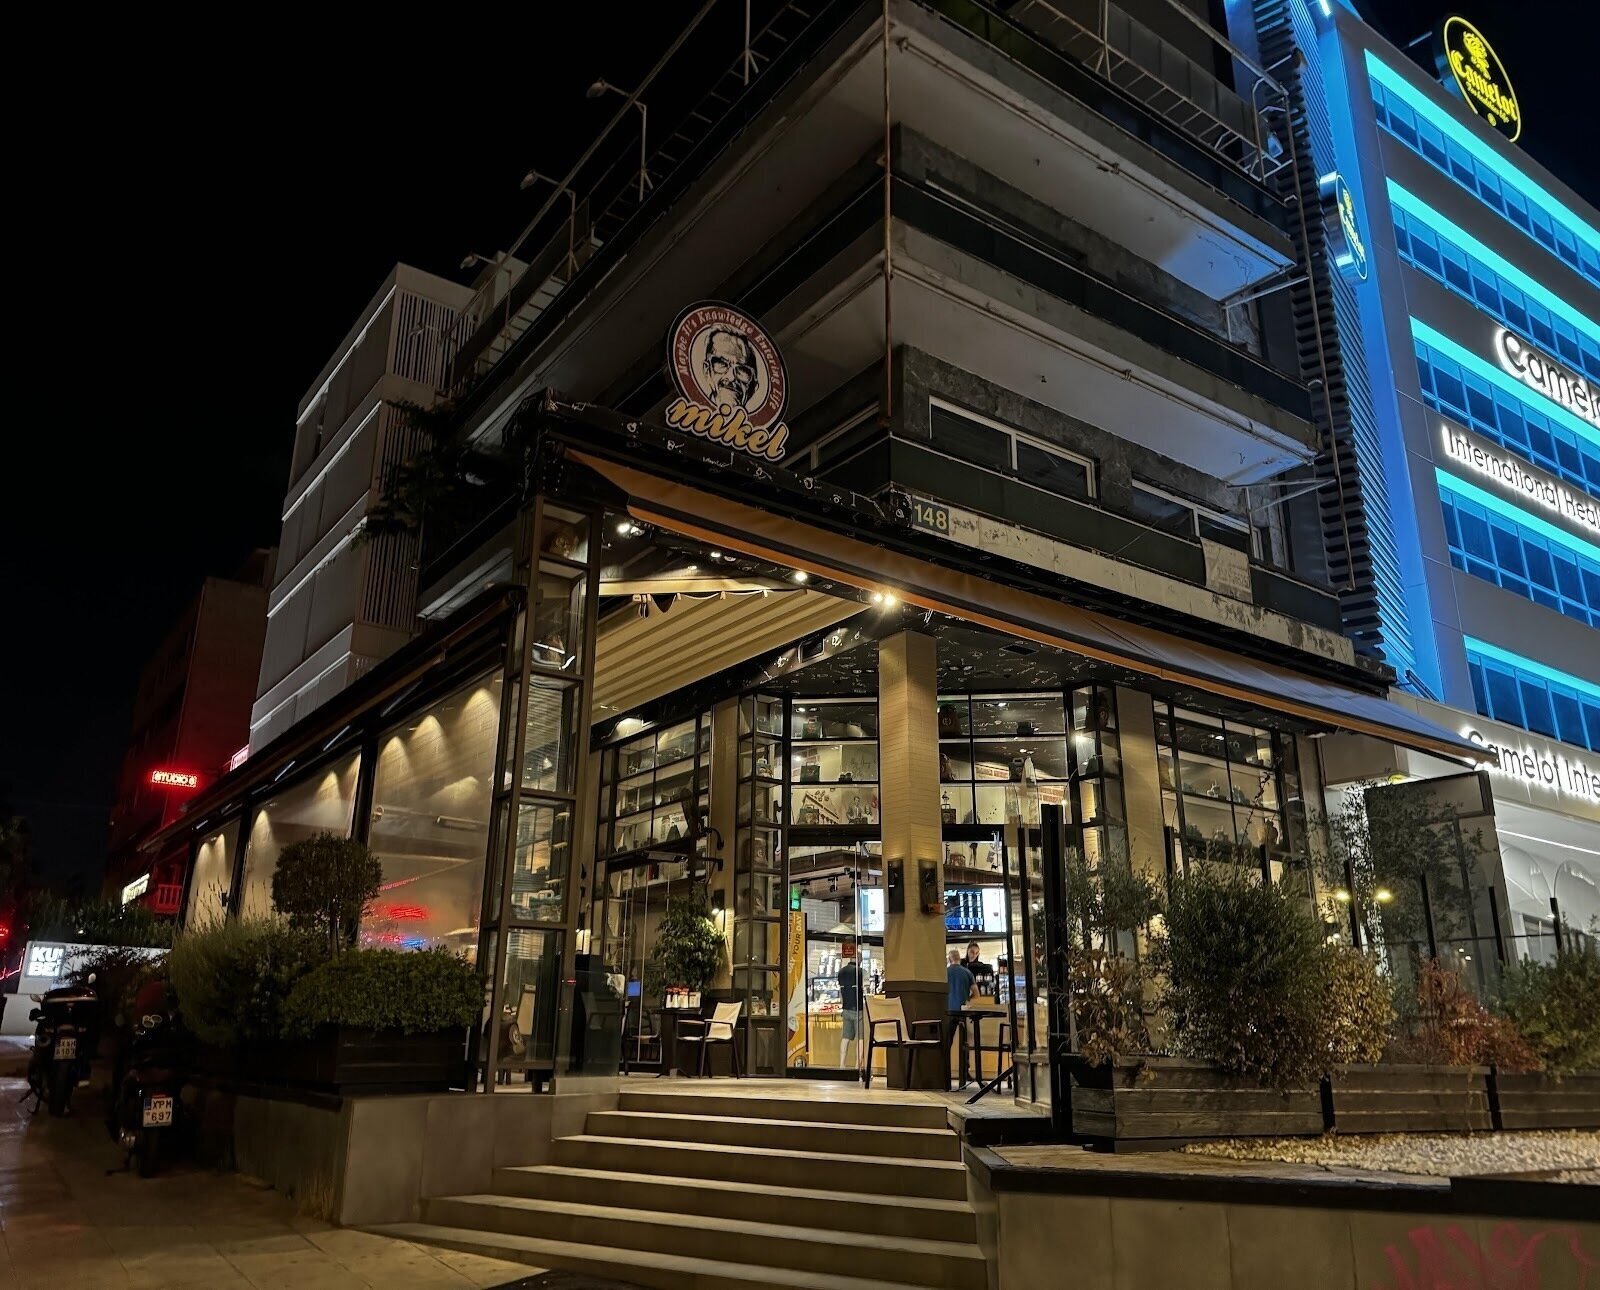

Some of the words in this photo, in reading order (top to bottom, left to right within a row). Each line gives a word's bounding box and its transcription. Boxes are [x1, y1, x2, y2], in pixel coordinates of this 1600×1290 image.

[677, 336, 689, 376] Maybe
[696, 309, 754, 335] Knowledge
[755, 335, 781, 384] Entering
[770, 386, 782, 411] Life
[1498, 328, 1600, 423] Camel
[667, 398, 788, 461] mikel
[1446, 427, 1561, 513] International
[914, 503, 947, 530] 148
[792, 933, 801, 955] YOUR
